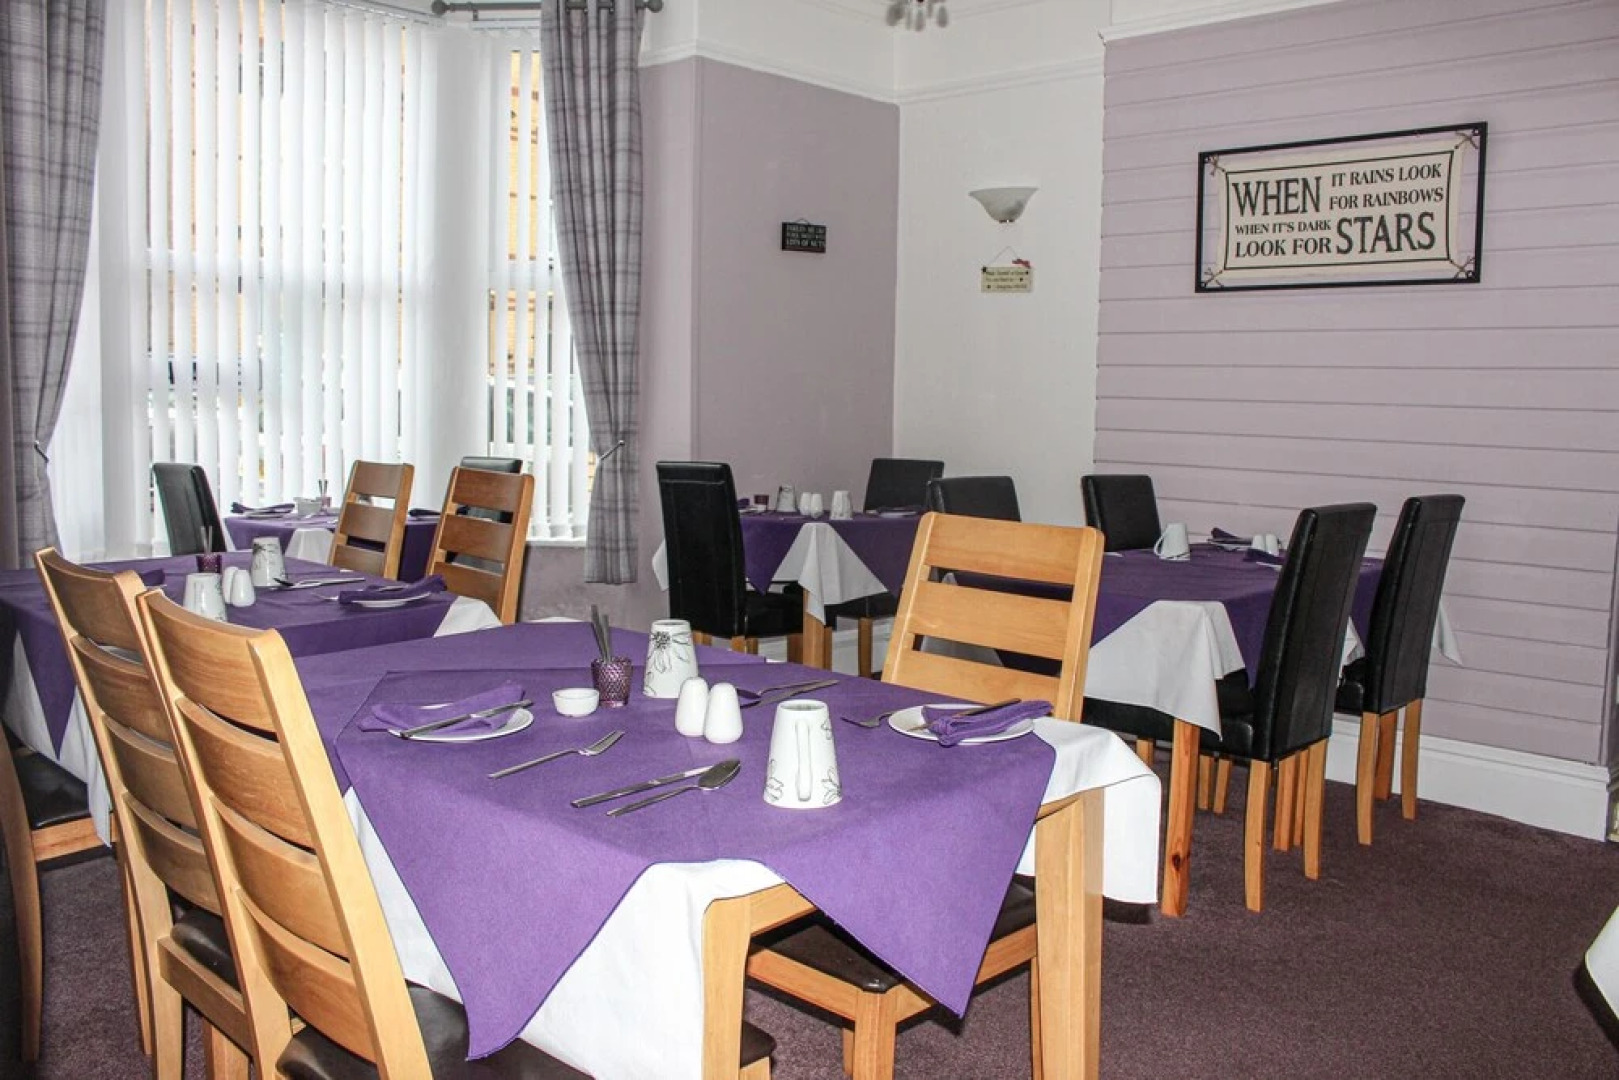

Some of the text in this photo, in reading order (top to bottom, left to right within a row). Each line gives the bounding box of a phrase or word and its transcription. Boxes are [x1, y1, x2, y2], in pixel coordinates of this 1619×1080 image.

[1331, 163, 1442, 187] IT RAINS LOOK
[1231, 176, 1322, 217] WHEN
[1329, 187, 1444, 210] FOR RAINBOWS
[1235, 219, 1332, 235] WHEN IT'S DARK
[1336, 211, 1436, 255] STARS
[1235, 237, 1332, 258] LOOK FOR
